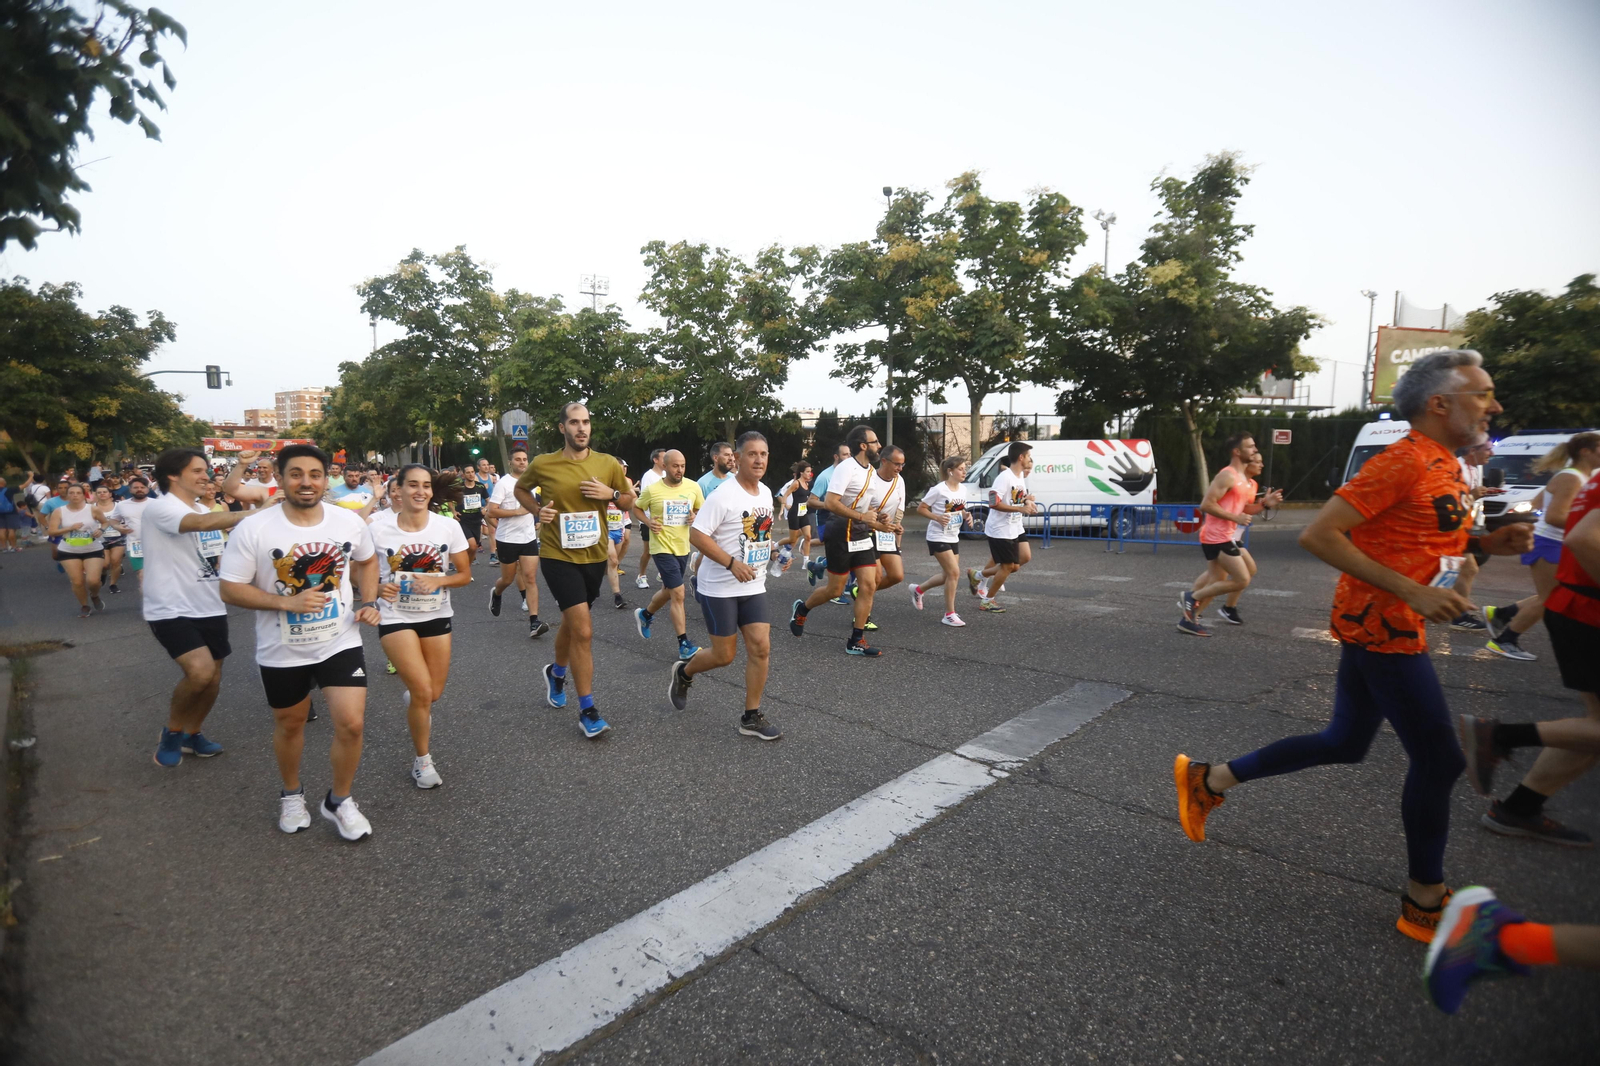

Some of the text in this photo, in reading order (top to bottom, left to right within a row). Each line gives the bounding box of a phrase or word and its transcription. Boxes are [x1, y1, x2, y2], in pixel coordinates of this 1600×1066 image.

[1034, 464, 1074, 473] ACANSA
[668, 506, 689, 514] 2296
[568, 520, 595, 532] 2627
[751, 549, 769, 561] 1823
[292, 603, 334, 622] 1507
